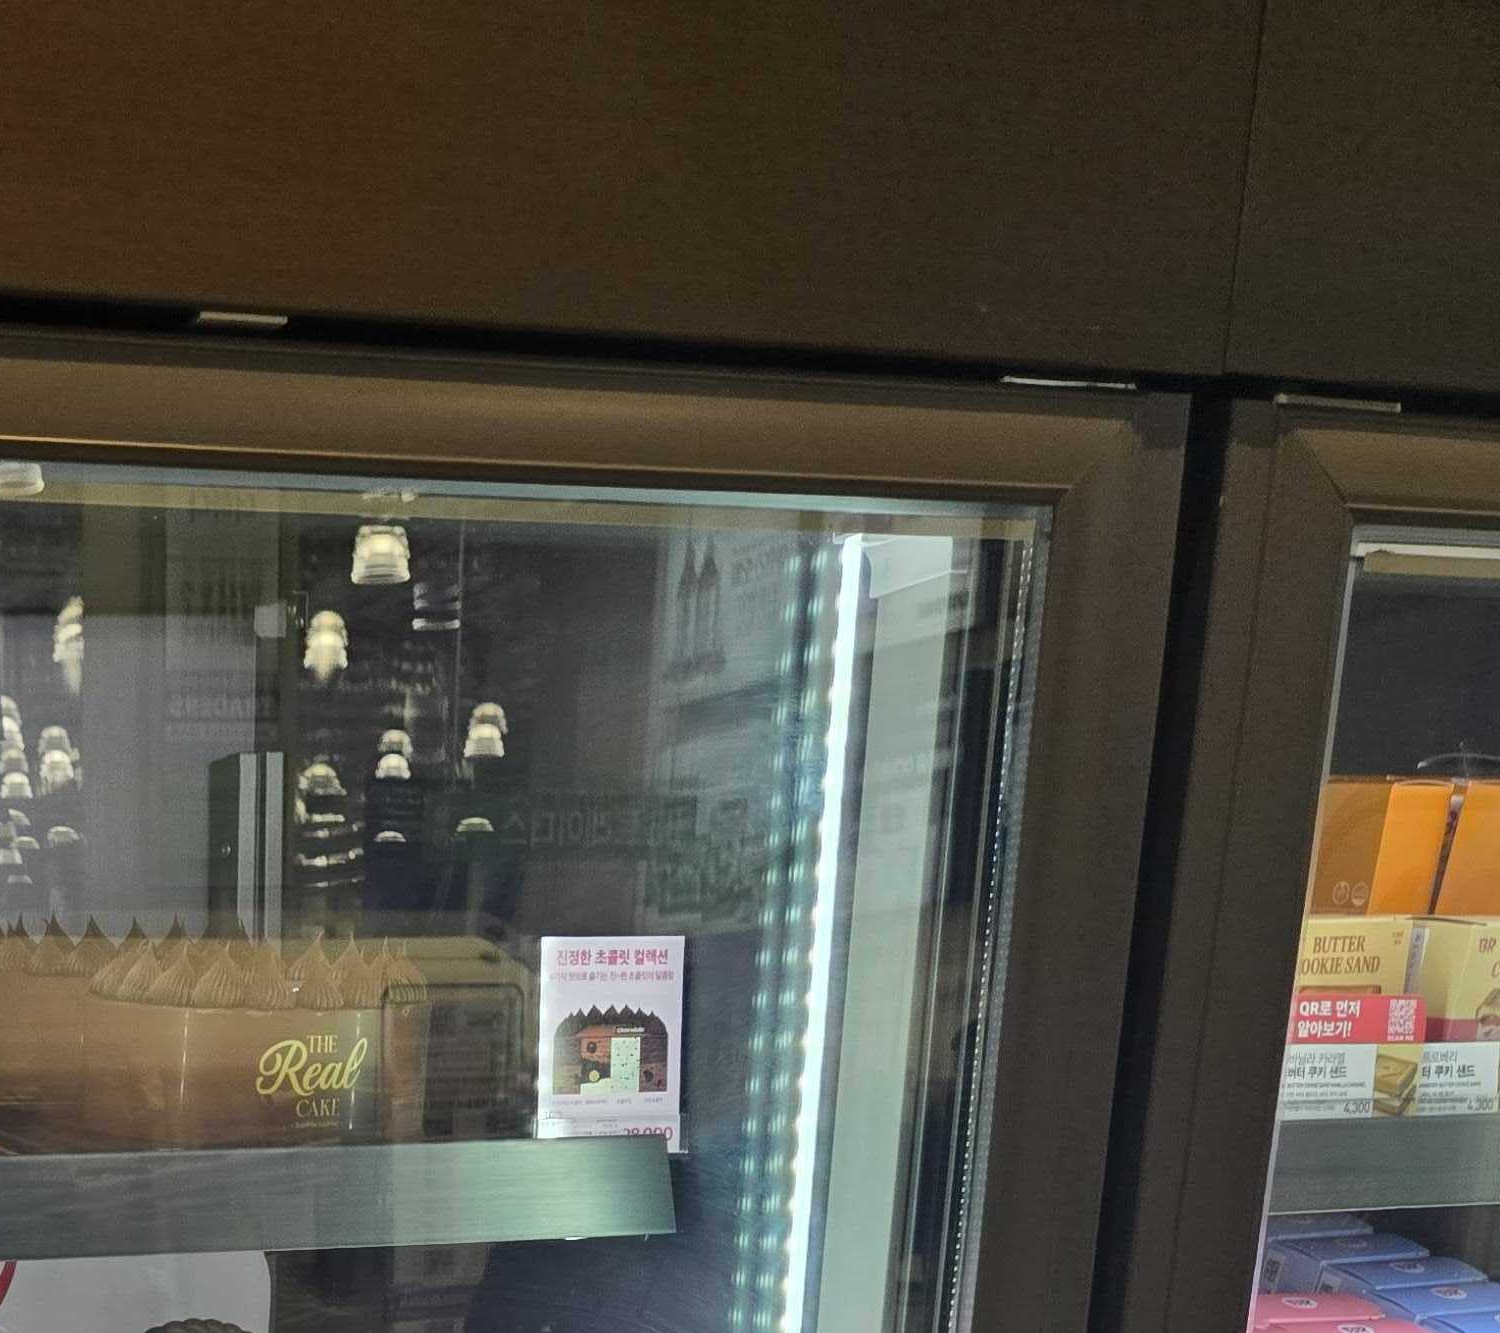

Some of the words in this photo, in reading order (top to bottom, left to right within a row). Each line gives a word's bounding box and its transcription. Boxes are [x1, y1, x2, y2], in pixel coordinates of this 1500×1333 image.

[1312, 935, 1366, 953] BUTTER
[556, 949, 592, 966] 진정한
[634, 948, 668, 966] 컬렉션
[1344, 956, 1380, 975] SAND
[1300, 1002, 1332, 1017] QR로
[1336, 1000, 1360, 1017] 먼저
[1298, 1021, 1351, 1039] 알아보기!
[306, 1034, 338, 1053] THE
[256, 1037, 368, 1096] Real
[1434, 1065, 1454, 1078] 쿠키
[1457, 1064, 1476, 1077] 샌드
[296, 1098, 340, 1117] CAKE
[1344, 1102, 1371, 1114] 4,300
